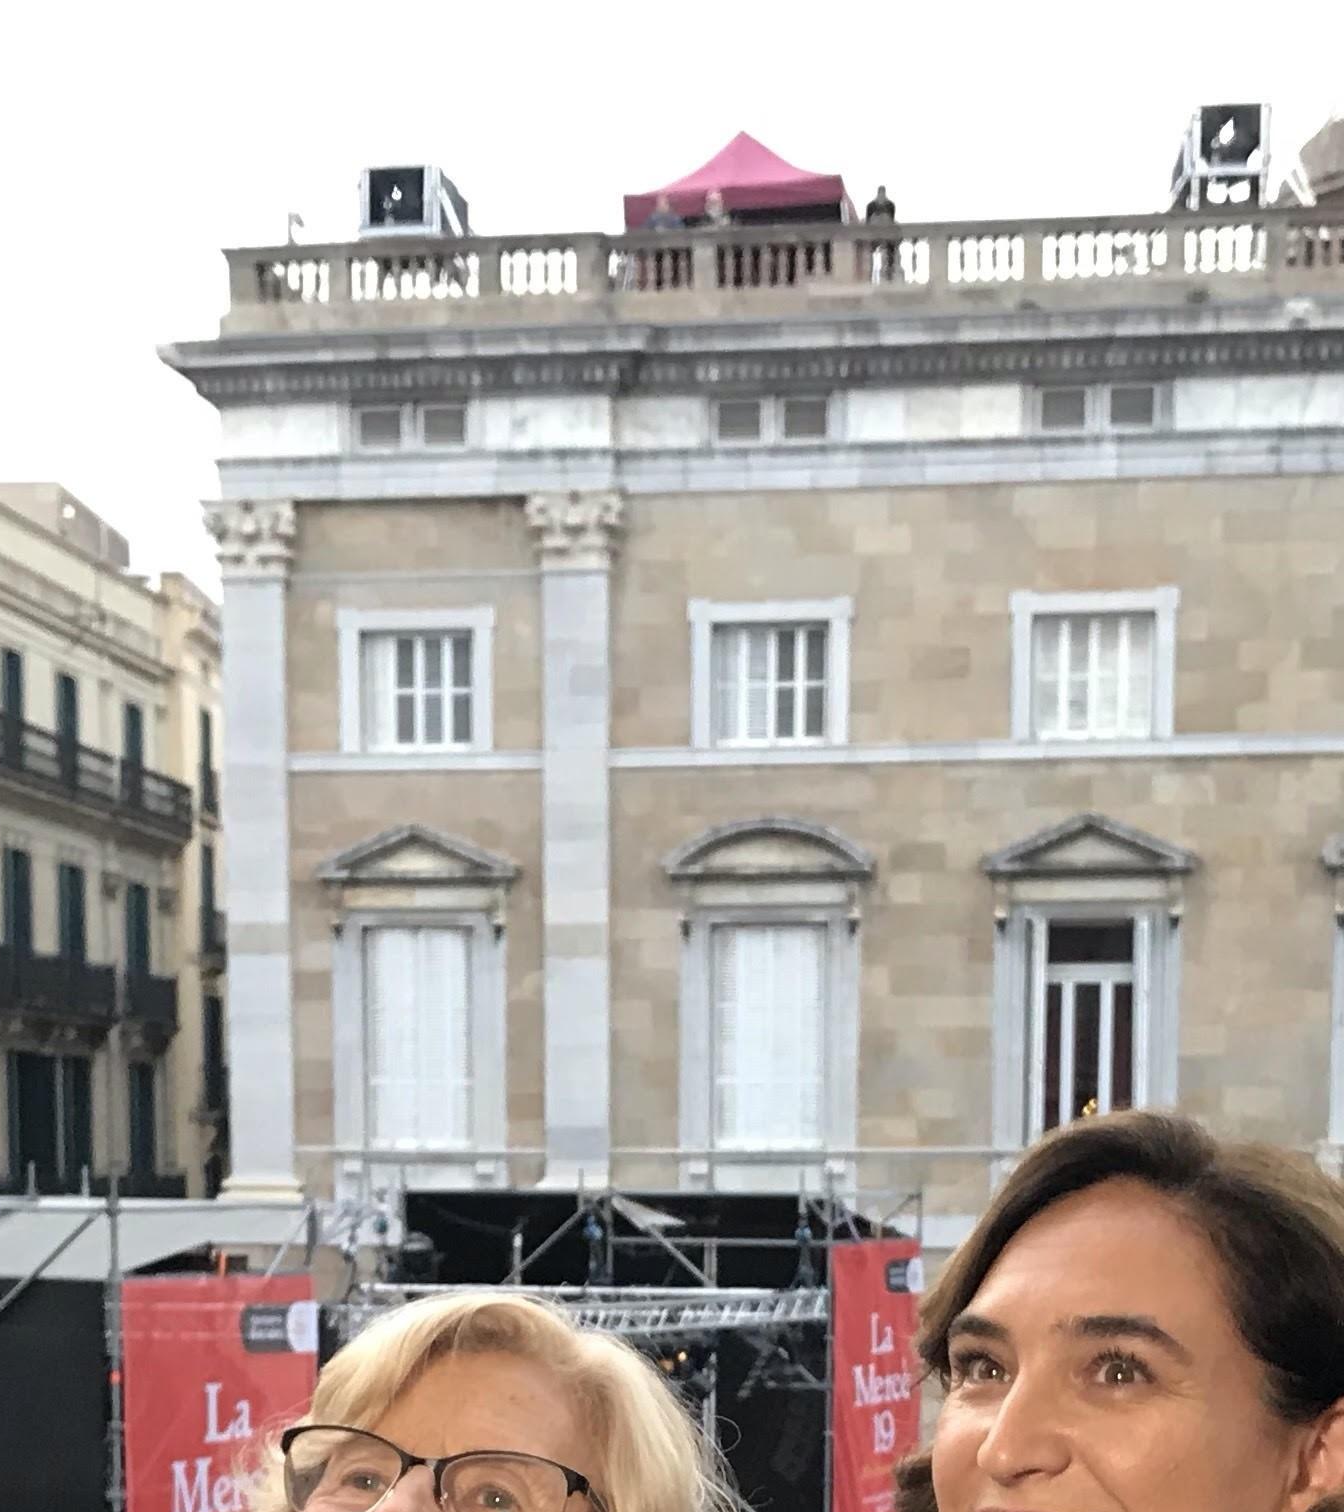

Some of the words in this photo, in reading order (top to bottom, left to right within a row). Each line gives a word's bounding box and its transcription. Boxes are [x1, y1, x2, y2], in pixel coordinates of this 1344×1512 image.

[870, 1311, 895, 1356] La
[203, 1382, 254, 1444] La
[873, 1409, 896, 1455] 19
